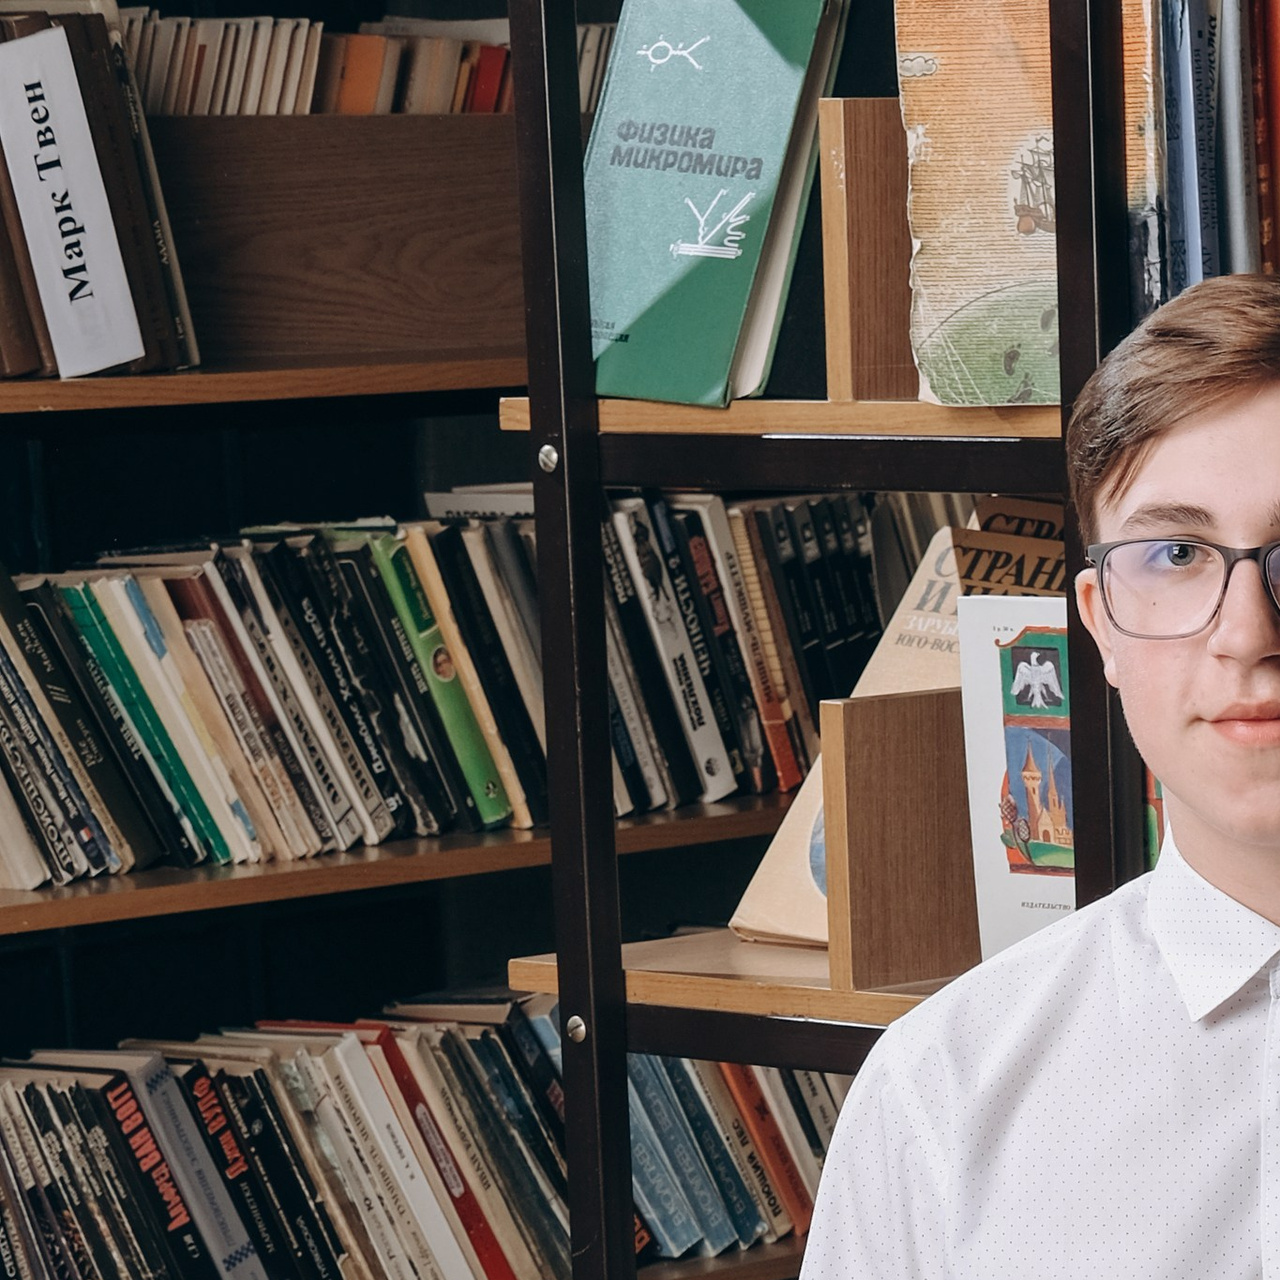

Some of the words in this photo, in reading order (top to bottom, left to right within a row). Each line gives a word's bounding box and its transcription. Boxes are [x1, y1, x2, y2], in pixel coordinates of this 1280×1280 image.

[17, 79, 64, 182] Твен
[616, 118, 715, 148] Физика
[1193, 48, 1206, 156] ФЕХТОВАНИЯ
[1199, 162, 1211, 229] УЧИТЕЛЬ
[45, 186, 99, 302] Марк
[895, 632, 960, 654] ЮГО-ВОС
[1021, 902, 1070, 911] ИЗДАТЕЛЬСТВО
[102, 1080, 147, 1135] ВОГТ
[187, 1073, 230, 1135] ВУЛФ
[434, 1085, 475, 1151] ЕФРЕМОВ
[125, 1126, 165, 1173] ВАН
[467, 1152, 493, 1191] ИВАН
[742, 1149, 785, 1218] ПОЮЩИЙ
[237, 1180, 278, 1254] МАРИОНЕТКИ
